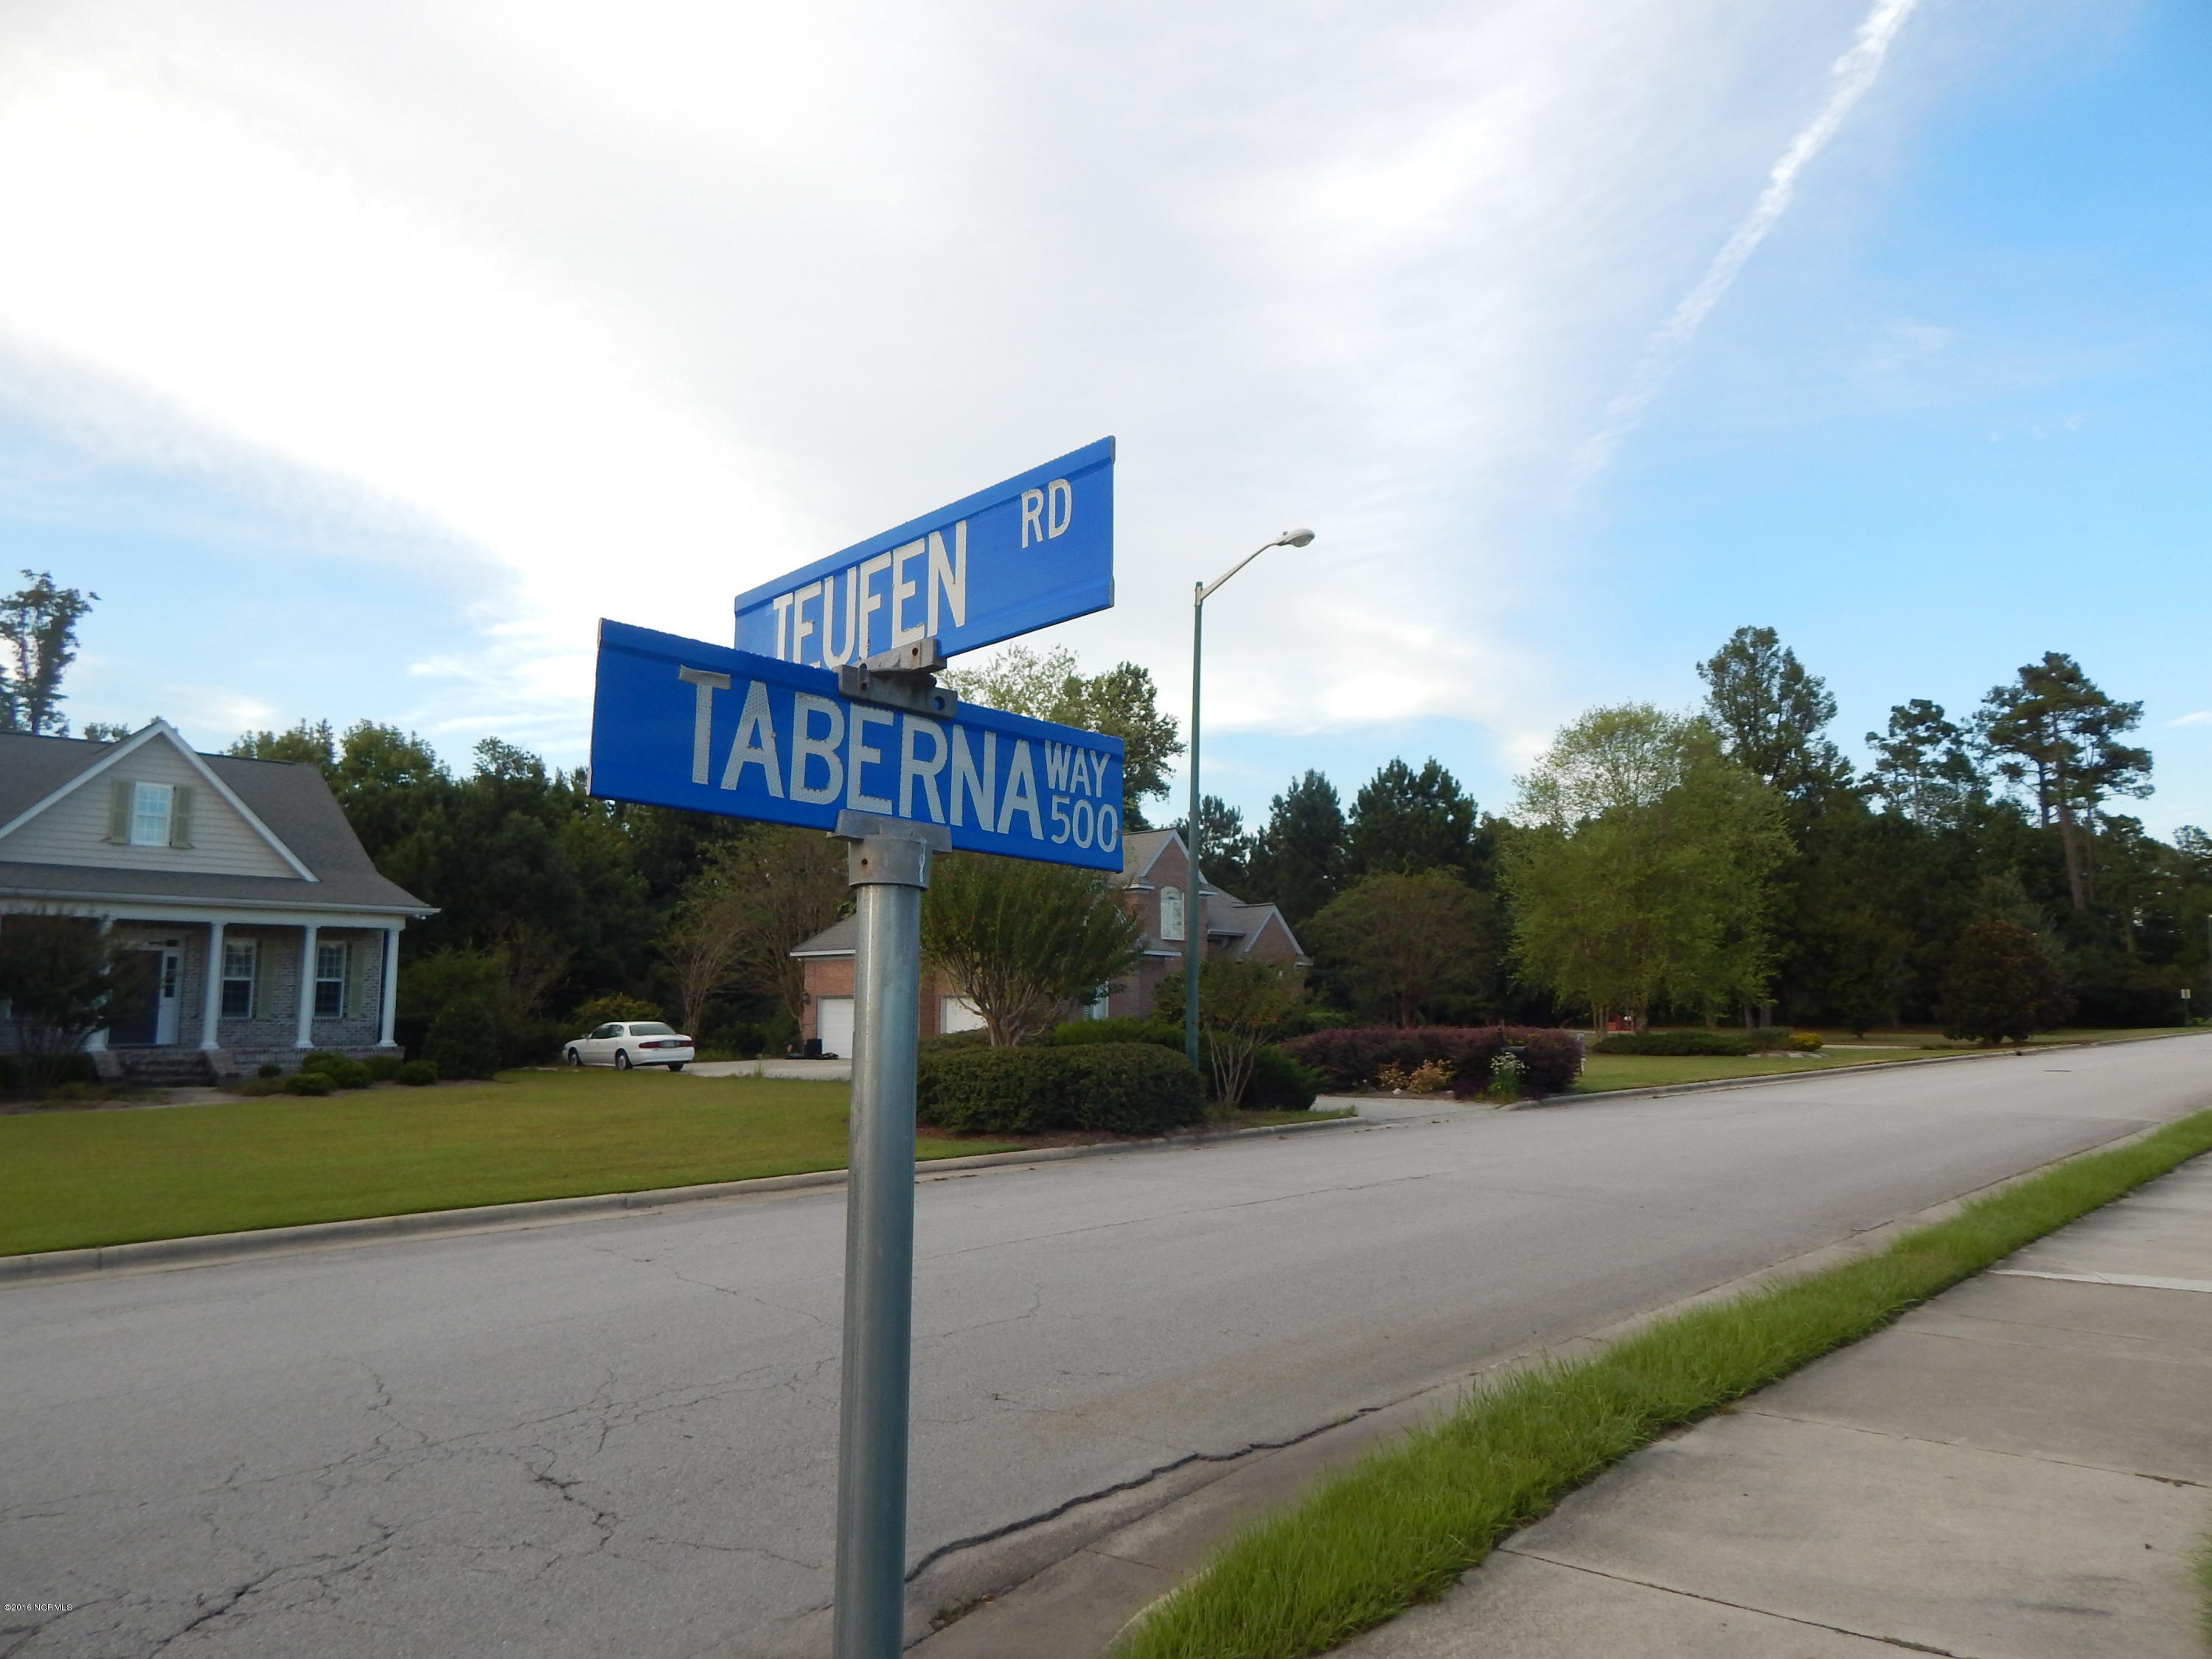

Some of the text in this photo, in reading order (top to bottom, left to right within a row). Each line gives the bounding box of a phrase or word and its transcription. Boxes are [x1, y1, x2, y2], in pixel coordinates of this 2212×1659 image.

[773, 478, 1073, 670] TEUFEN RD
[678, 664, 1110, 841] TABERNA WAY
[1051, 794, 1118, 852] 500
